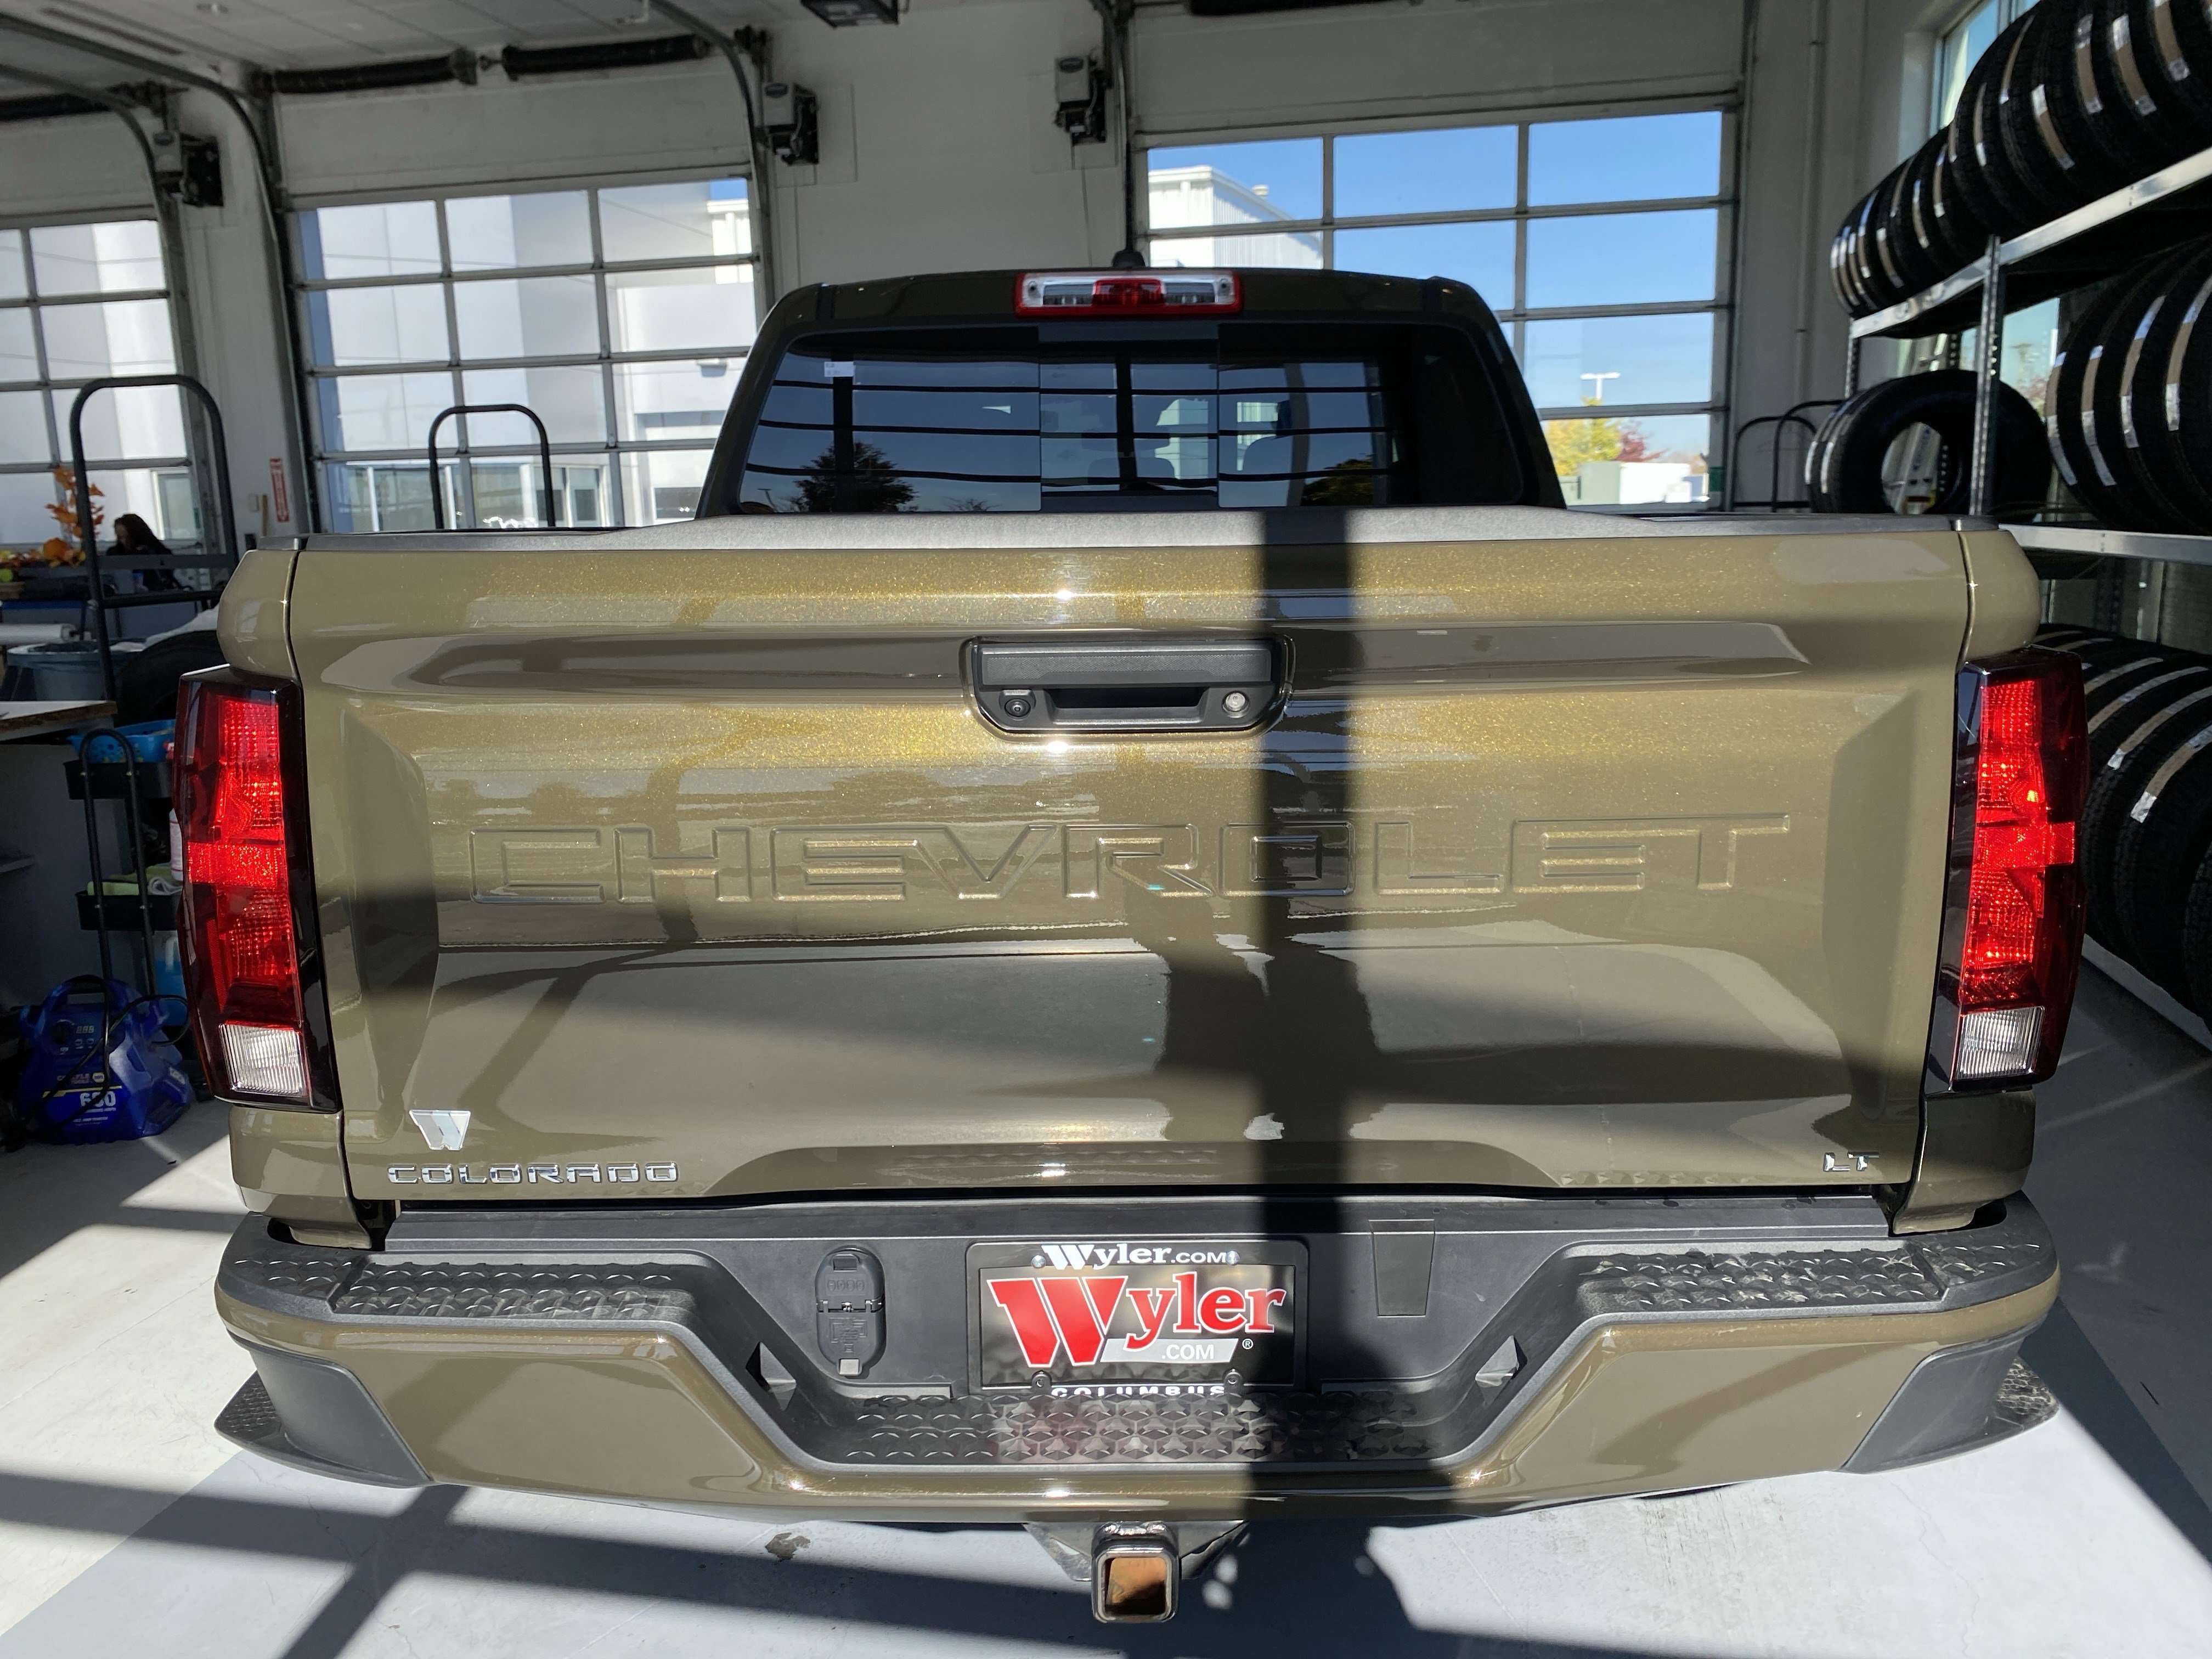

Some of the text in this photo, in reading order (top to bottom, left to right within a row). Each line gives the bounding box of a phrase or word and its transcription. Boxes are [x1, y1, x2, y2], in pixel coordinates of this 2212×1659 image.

[469, 814, 1791, 905] CHEVROLET
[387, 1161, 680, 1184] COLORADO
[1823, 1152, 1880, 1172] LT
[986, 1271, 1287, 1368] Wyler
